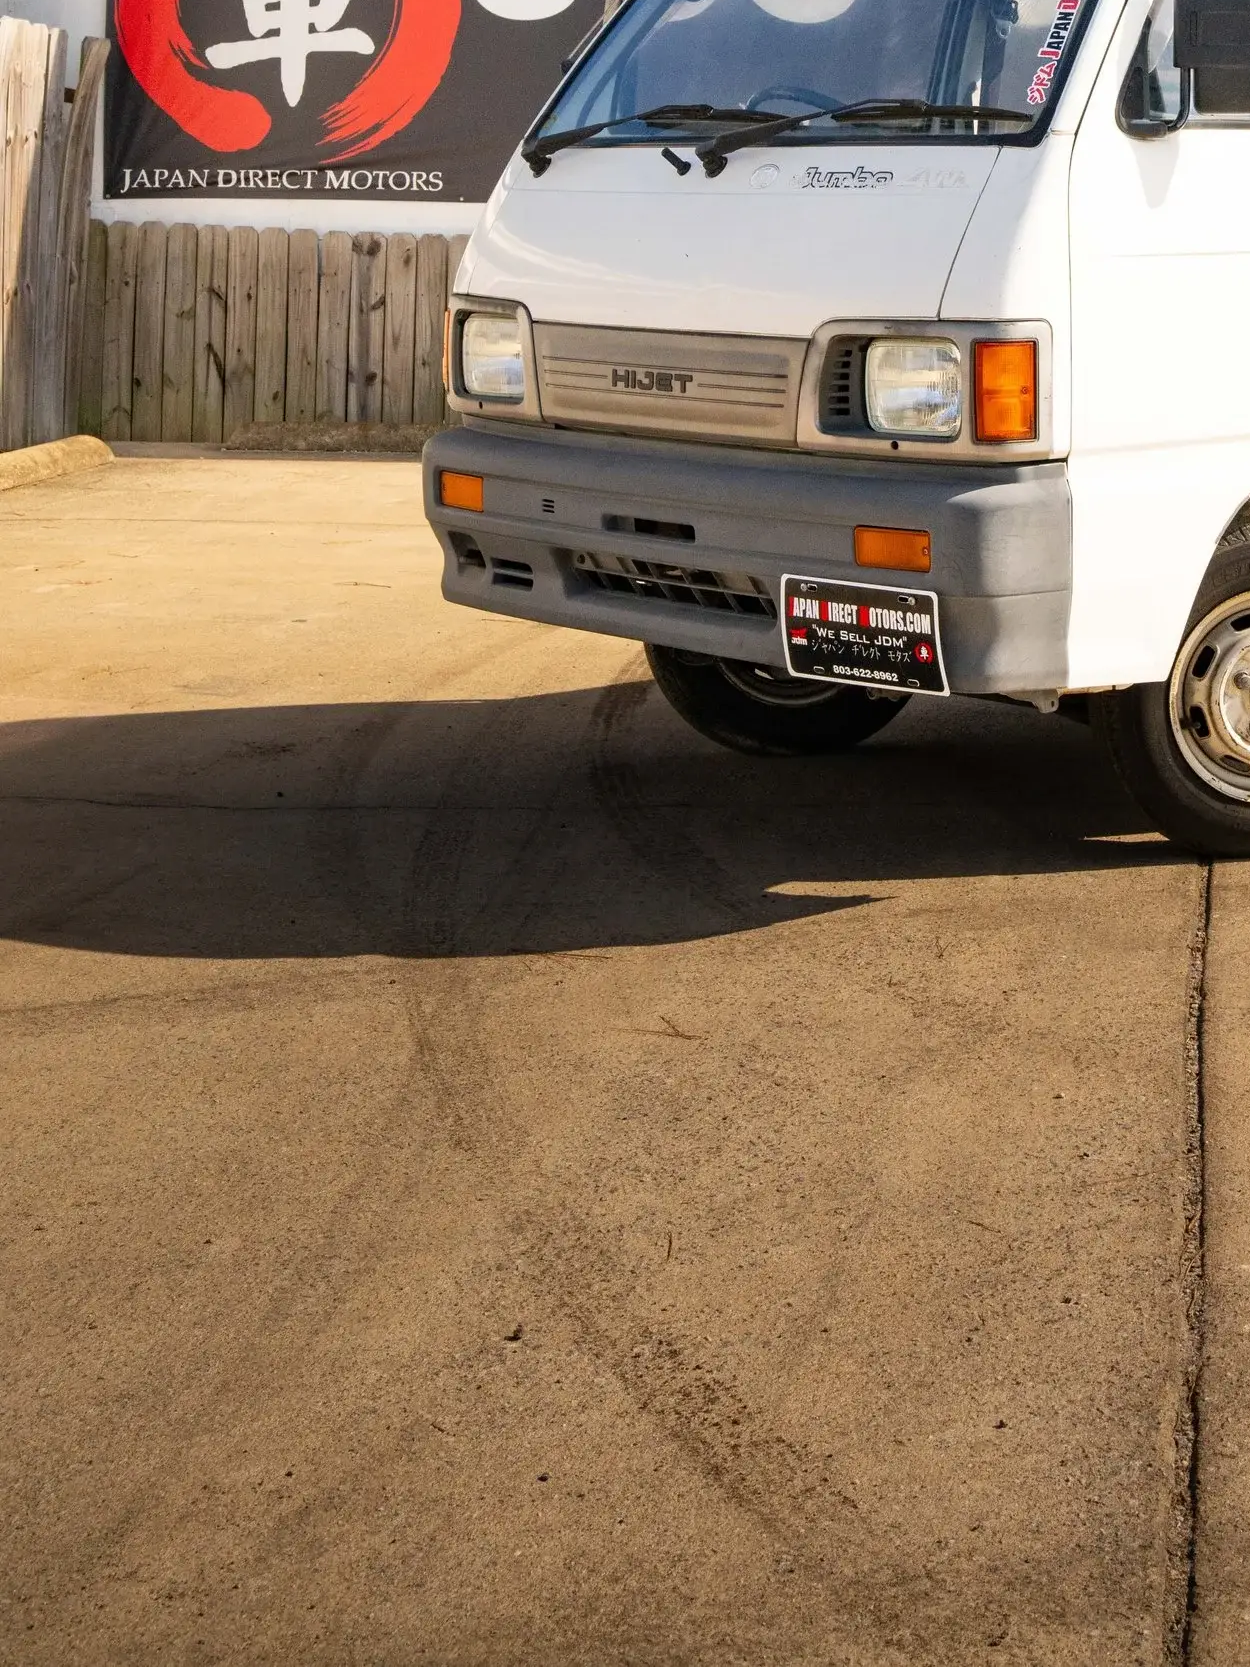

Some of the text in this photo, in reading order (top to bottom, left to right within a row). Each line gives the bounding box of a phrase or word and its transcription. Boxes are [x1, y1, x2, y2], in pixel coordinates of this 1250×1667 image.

[121, 168, 444, 193] JAPAN DIRECT MOTORS
[801, 166, 894, 189] Jumbo
[611, 368, 694, 394] HIJET
[832, 664, 899, 682] 803-622-8962
